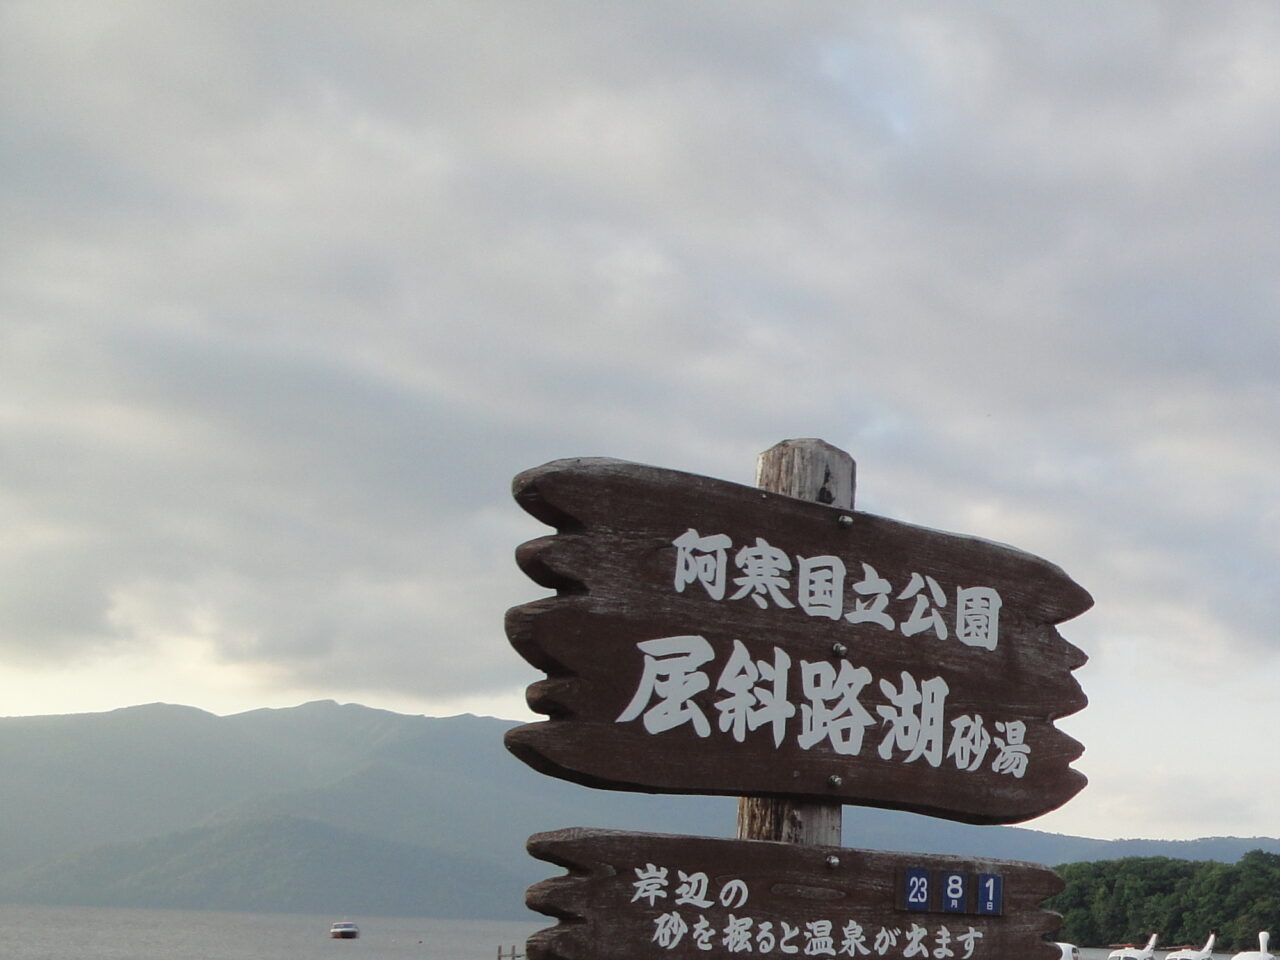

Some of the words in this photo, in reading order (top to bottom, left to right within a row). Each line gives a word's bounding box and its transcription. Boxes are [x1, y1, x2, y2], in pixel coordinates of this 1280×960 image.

[672, 528, 1002, 651] 阿寒国立公園
[630, 862, 749, 909] 岸辺の
[908, 876, 928, 903] 23
[651, 911, 984, 960] 砂を掘ると温泉が出ます
